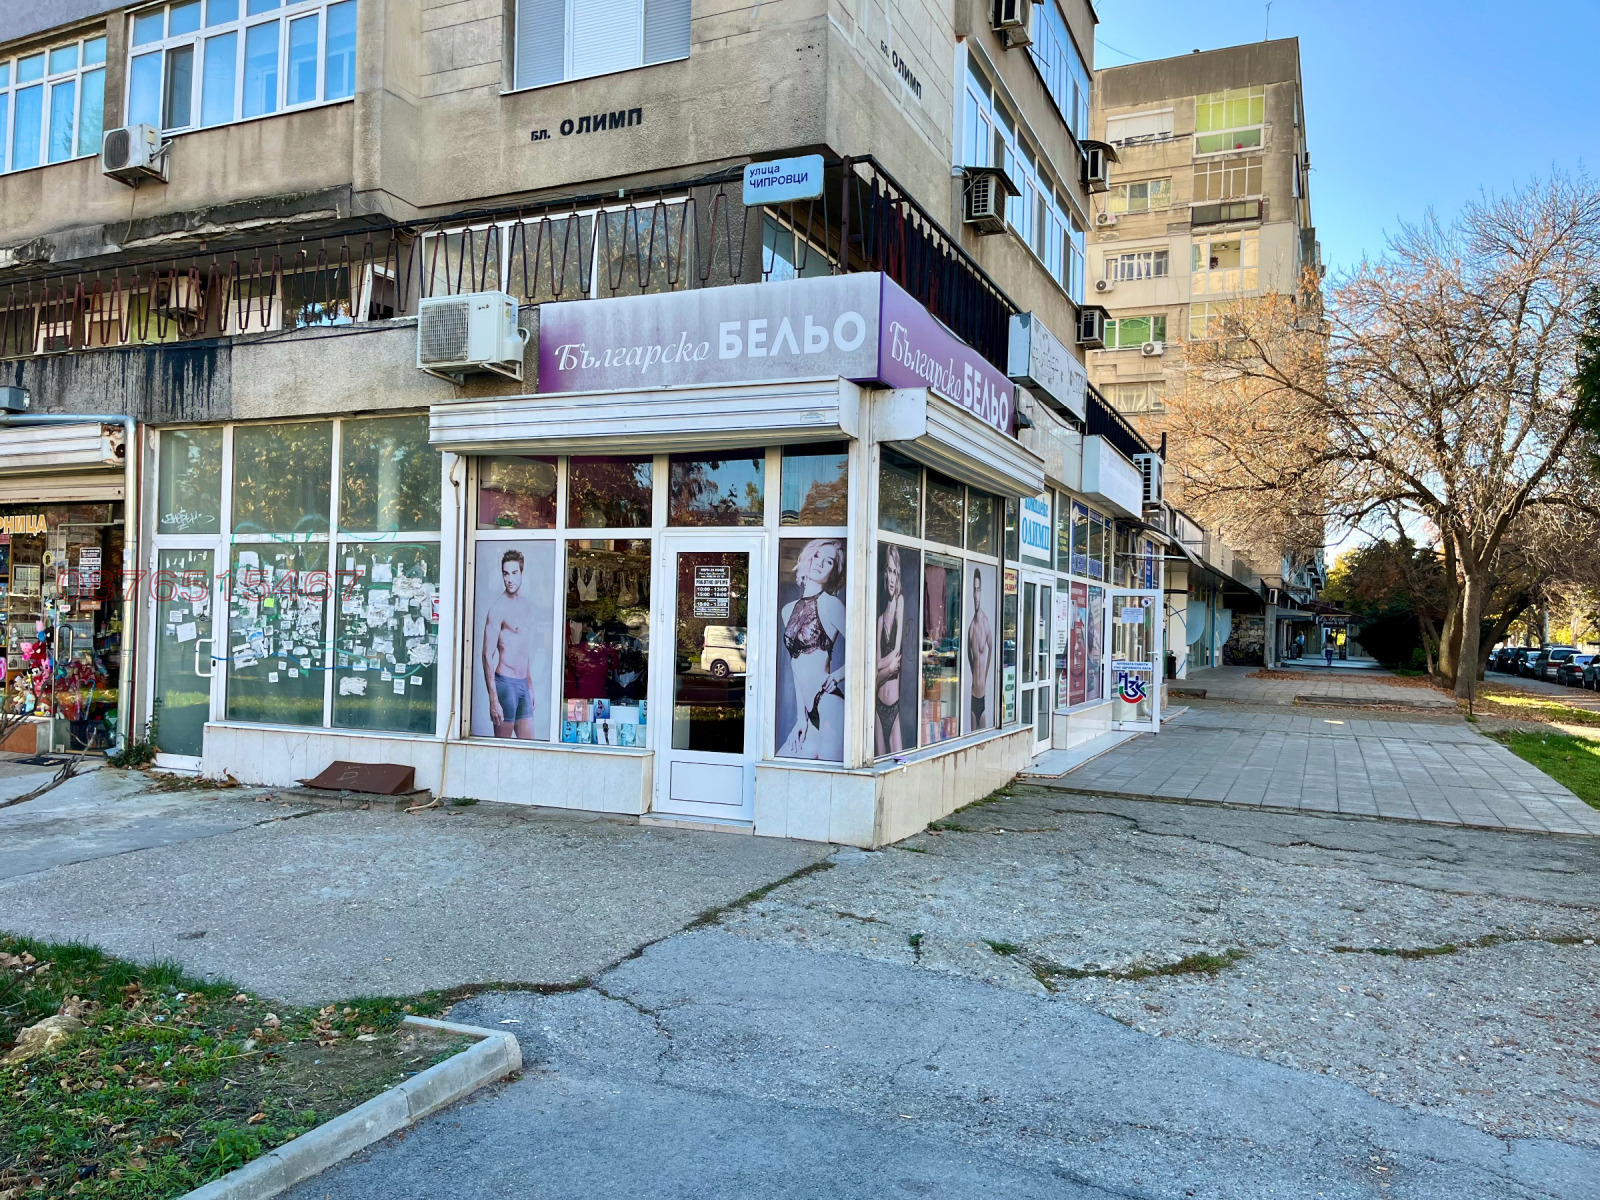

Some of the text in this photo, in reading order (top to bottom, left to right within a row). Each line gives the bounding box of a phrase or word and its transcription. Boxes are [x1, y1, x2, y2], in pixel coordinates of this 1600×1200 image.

[892, 49, 922, 101] ОЛИМП
[560, 107, 643, 137] ОЛИМП
[749, 164, 780, 179] улица
[749, 171, 809, 190] ЧИПРОВЦИ
[555, 311, 867, 375] Българско БЕЛЬО
[890, 321, 962, 401] Българско
[964, 361, 1009, 432] БЕЛЬО
[1021, 517, 1050, 551] ОЛИМП
